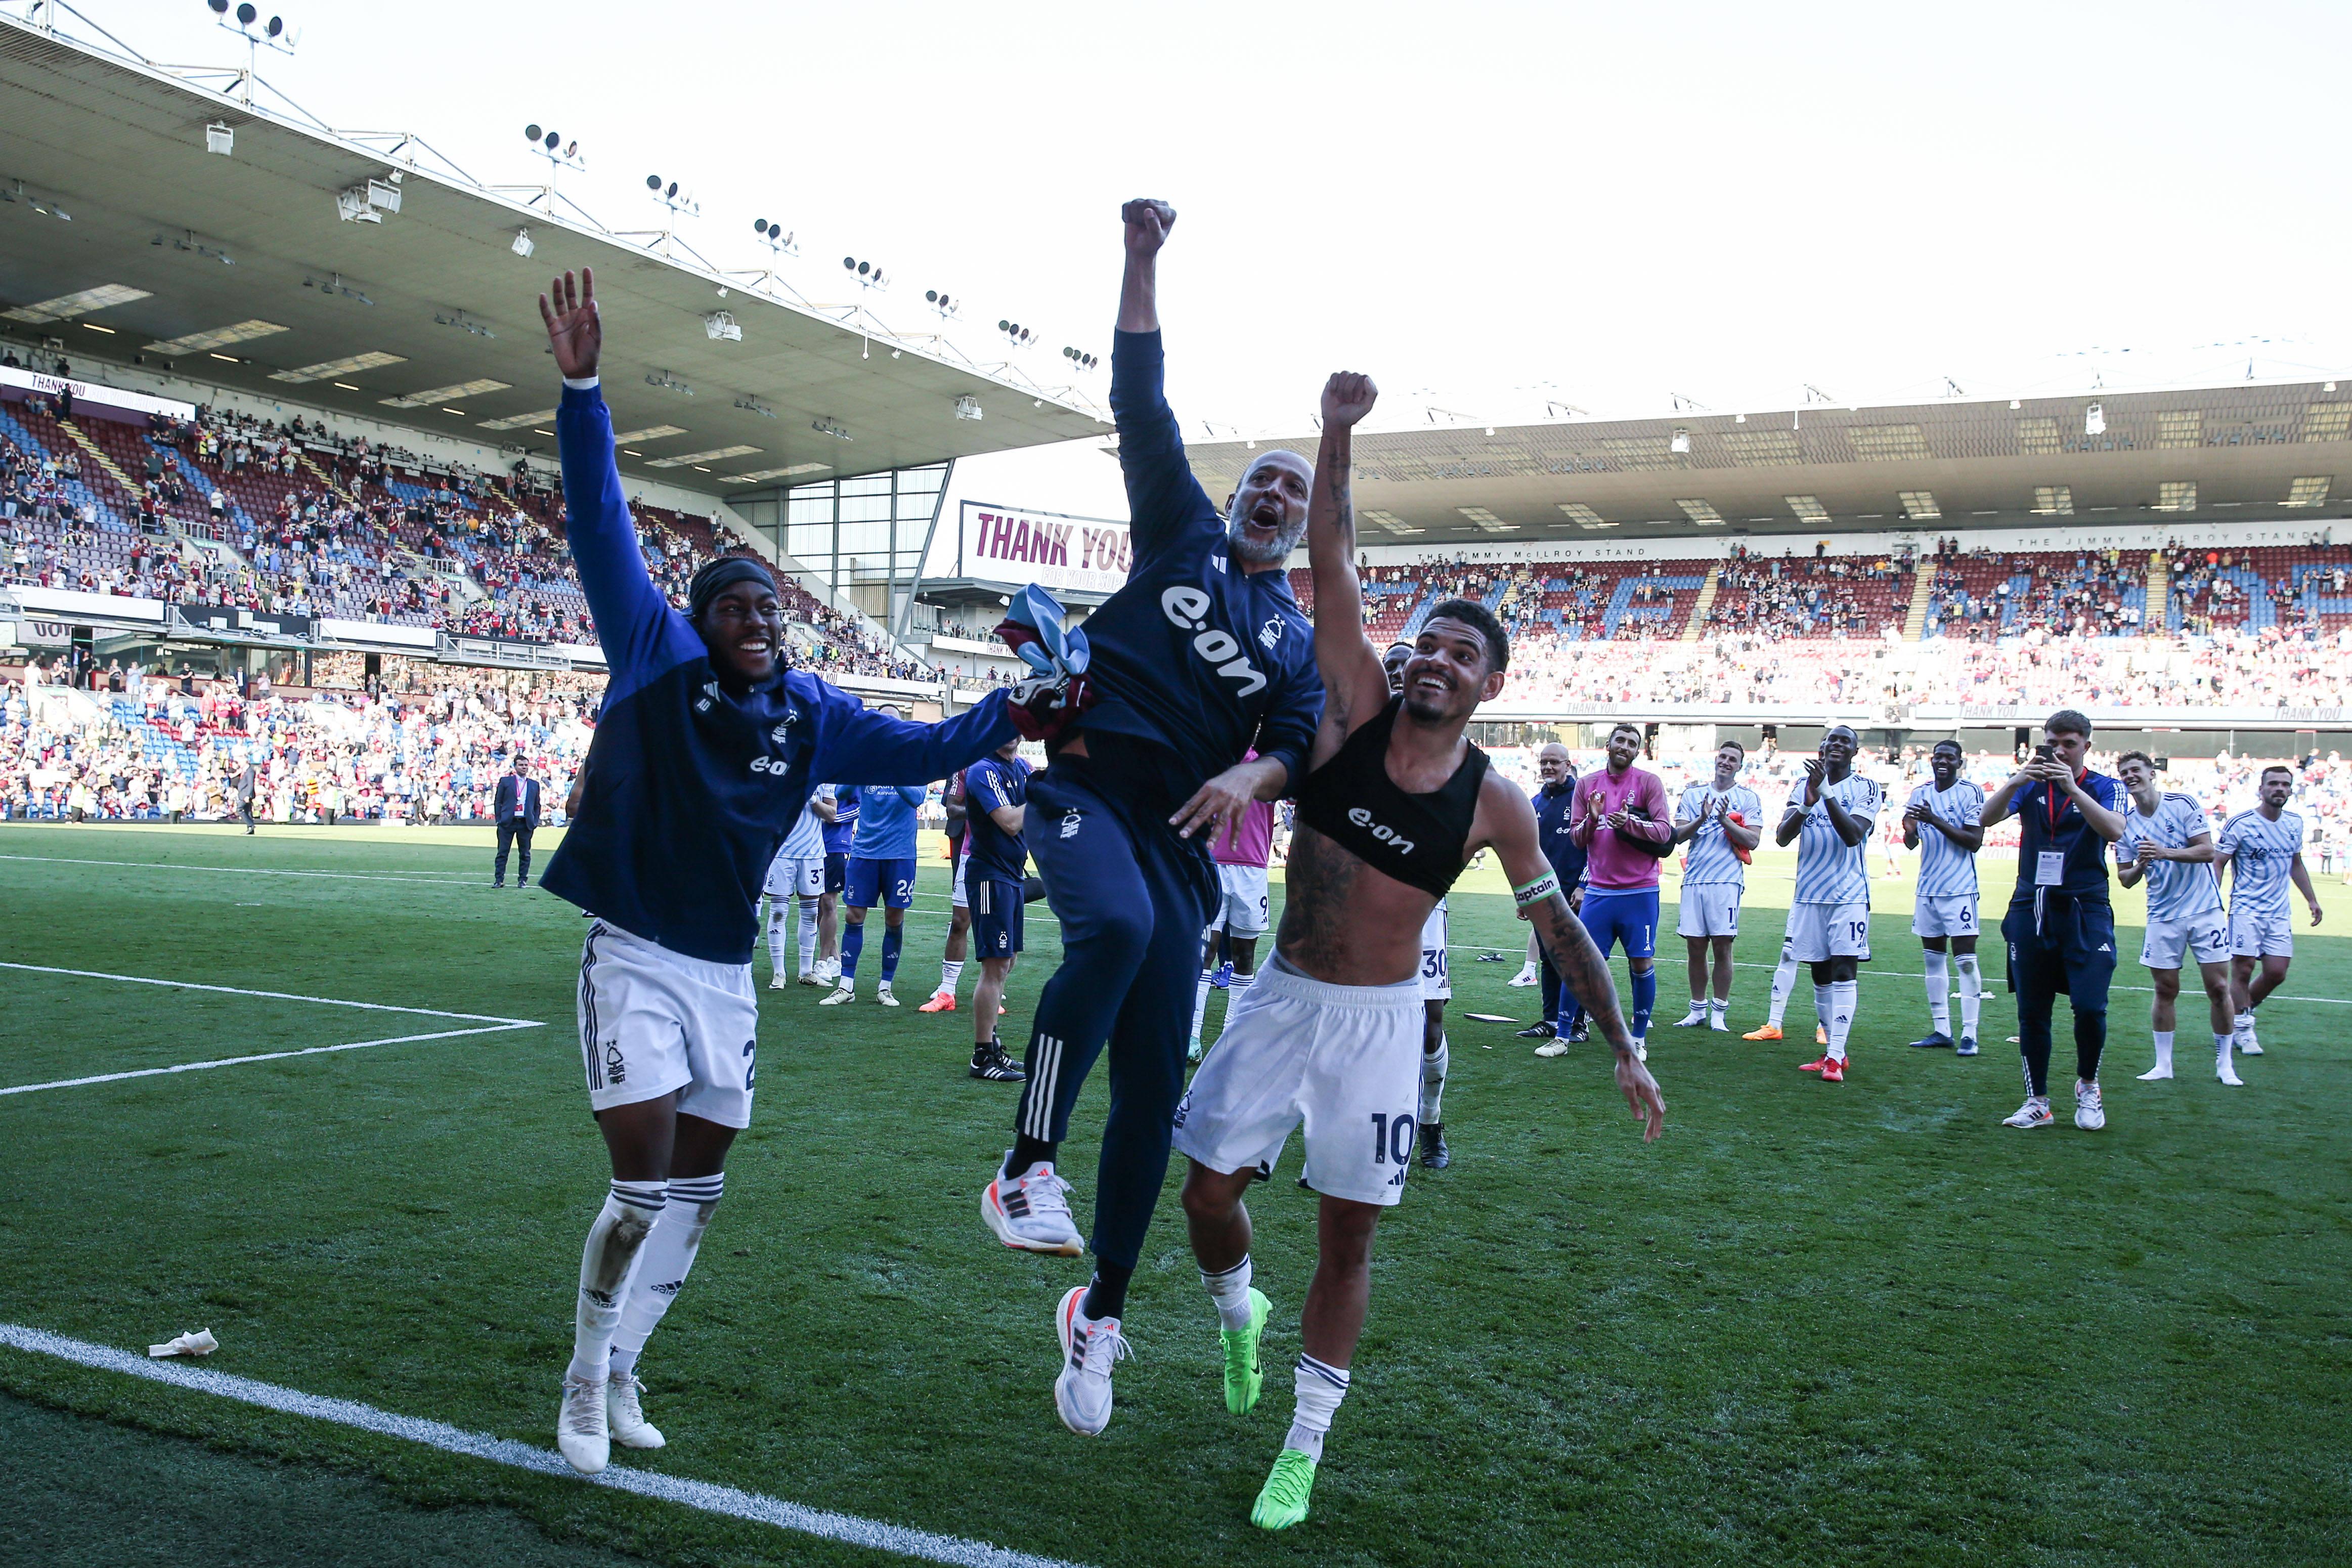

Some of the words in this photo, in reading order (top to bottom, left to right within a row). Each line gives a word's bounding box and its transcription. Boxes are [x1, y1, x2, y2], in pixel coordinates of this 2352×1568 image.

[32, 375, 64, 393] THANK
[977, 513, 1074, 567] THANK
[1082, 527, 1133, 573] YOU
[1041, 567, 1064, 586] FOR
[1067, 569, 1097, 589] YOUR
[826, 672, 838, 685] YOU
[1566, 703, 1597, 714] THANK
[1600, 703, 1618, 714] YOU
[1959, 705, 1994, 718] THANK
[1997, 705, 2018, 718] YOU
[2275, 707, 2313, 721] THANK
[2318, 708, 2341, 721] YOU
[897, 879, 914, 896] 26
[1260, 896, 1268, 916] 9
[1959, 905, 1971, 923] 6
[1645, 924, 1650, 944] 1
[1849, 921, 1865, 941] 19
[1422, 949, 1447, 978] 30
[1371, 1113, 1415, 1165] 10
[582, 1287, 617, 1309] adidas
